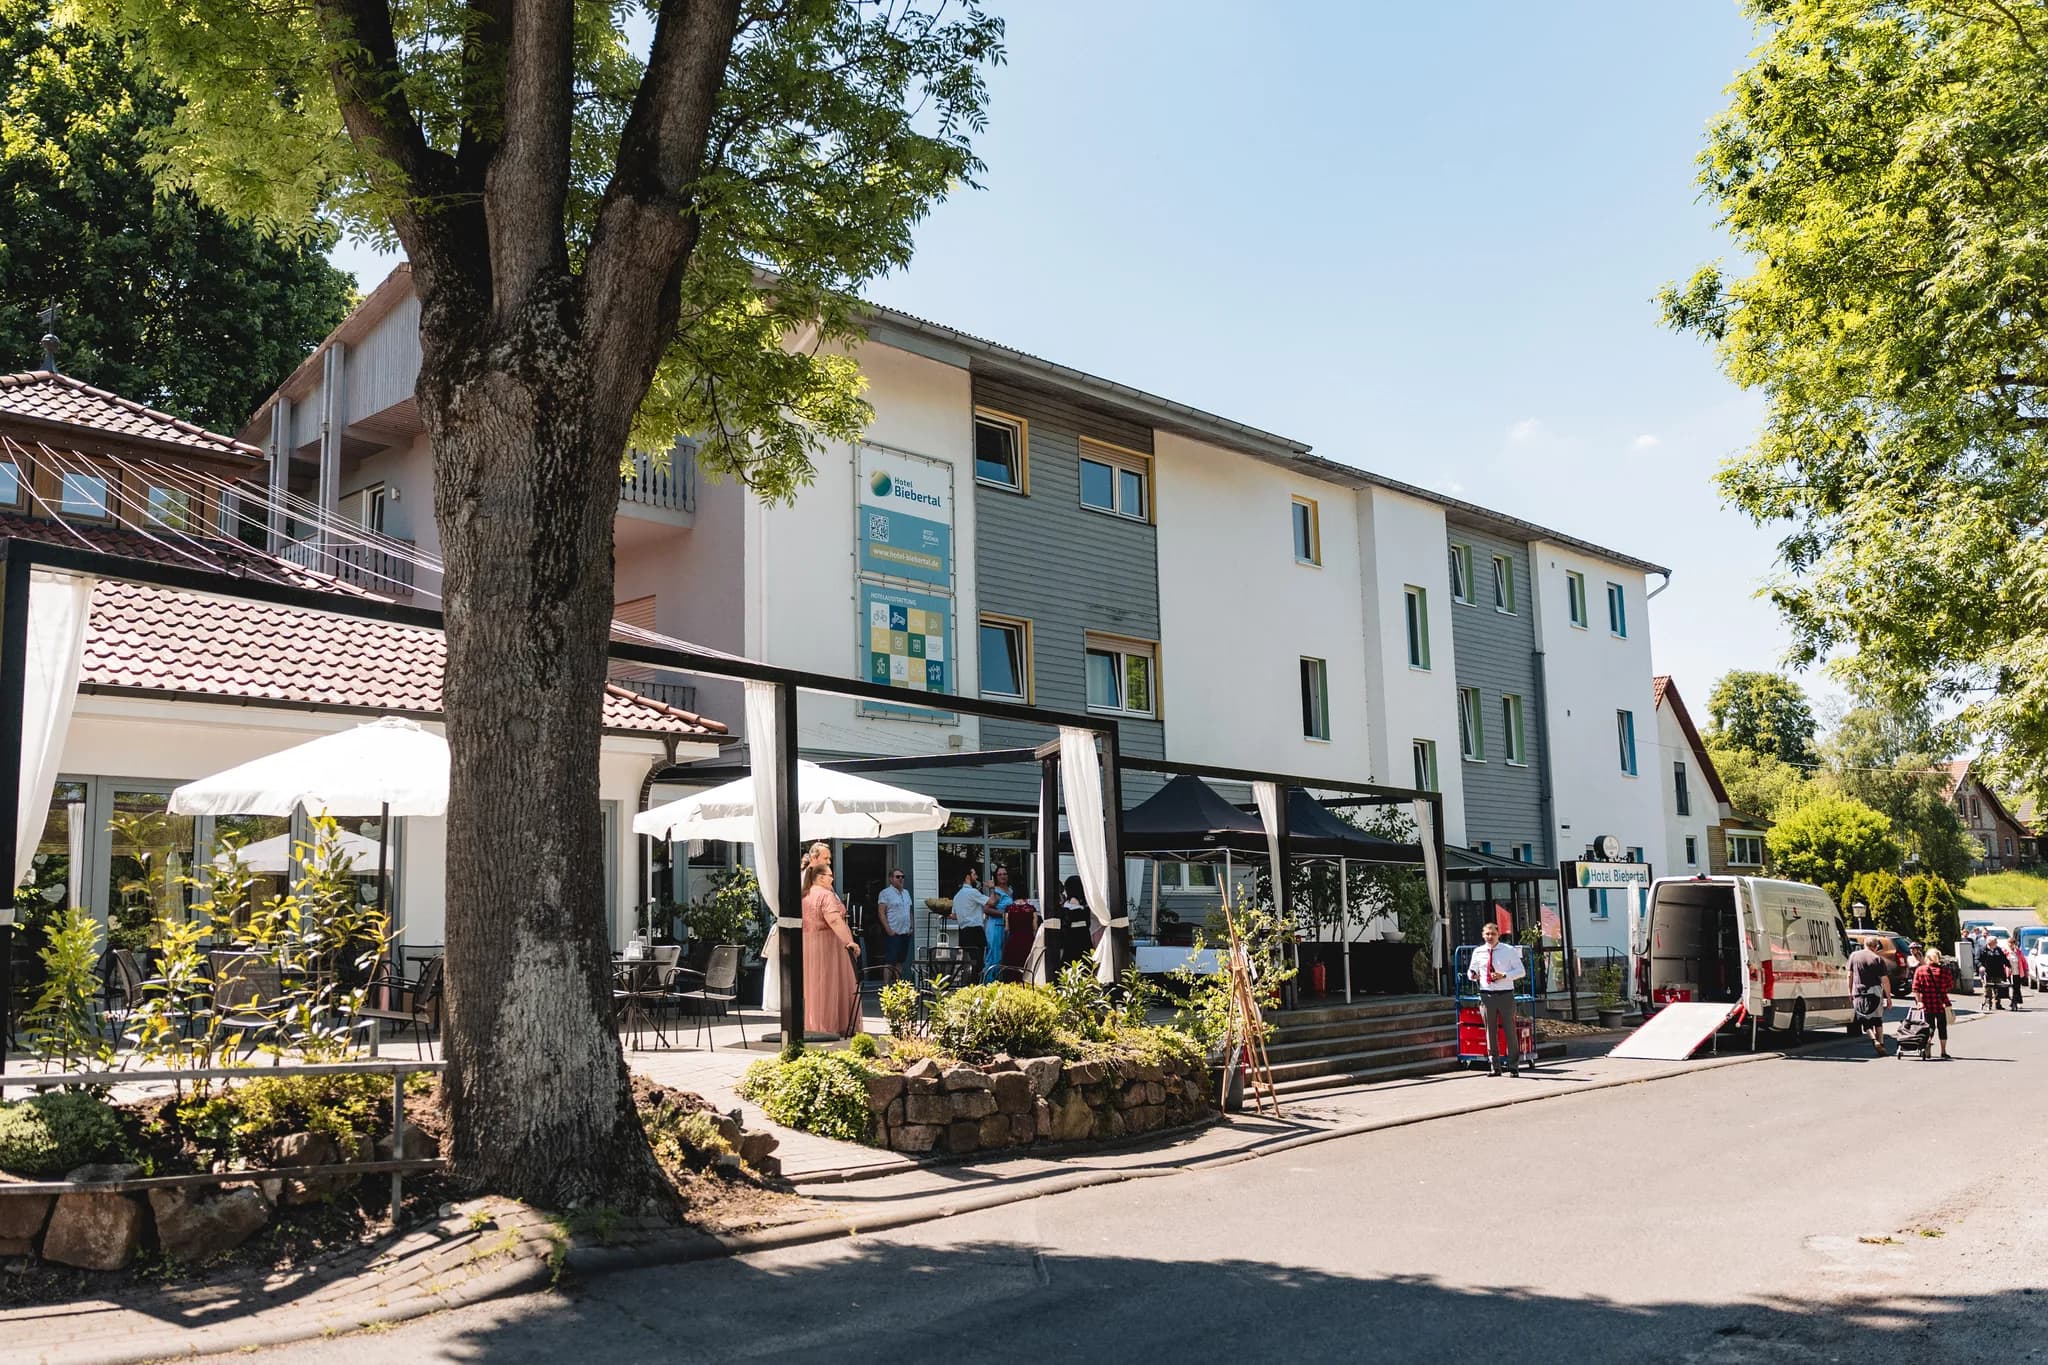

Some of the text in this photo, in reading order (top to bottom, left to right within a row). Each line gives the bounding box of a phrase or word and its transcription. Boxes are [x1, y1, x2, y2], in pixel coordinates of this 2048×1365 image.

[894, 477, 913, 488] Hotel
[894, 486, 941, 507] Biebertal
[1591, 870, 1647, 882] Hotel Biebertal
